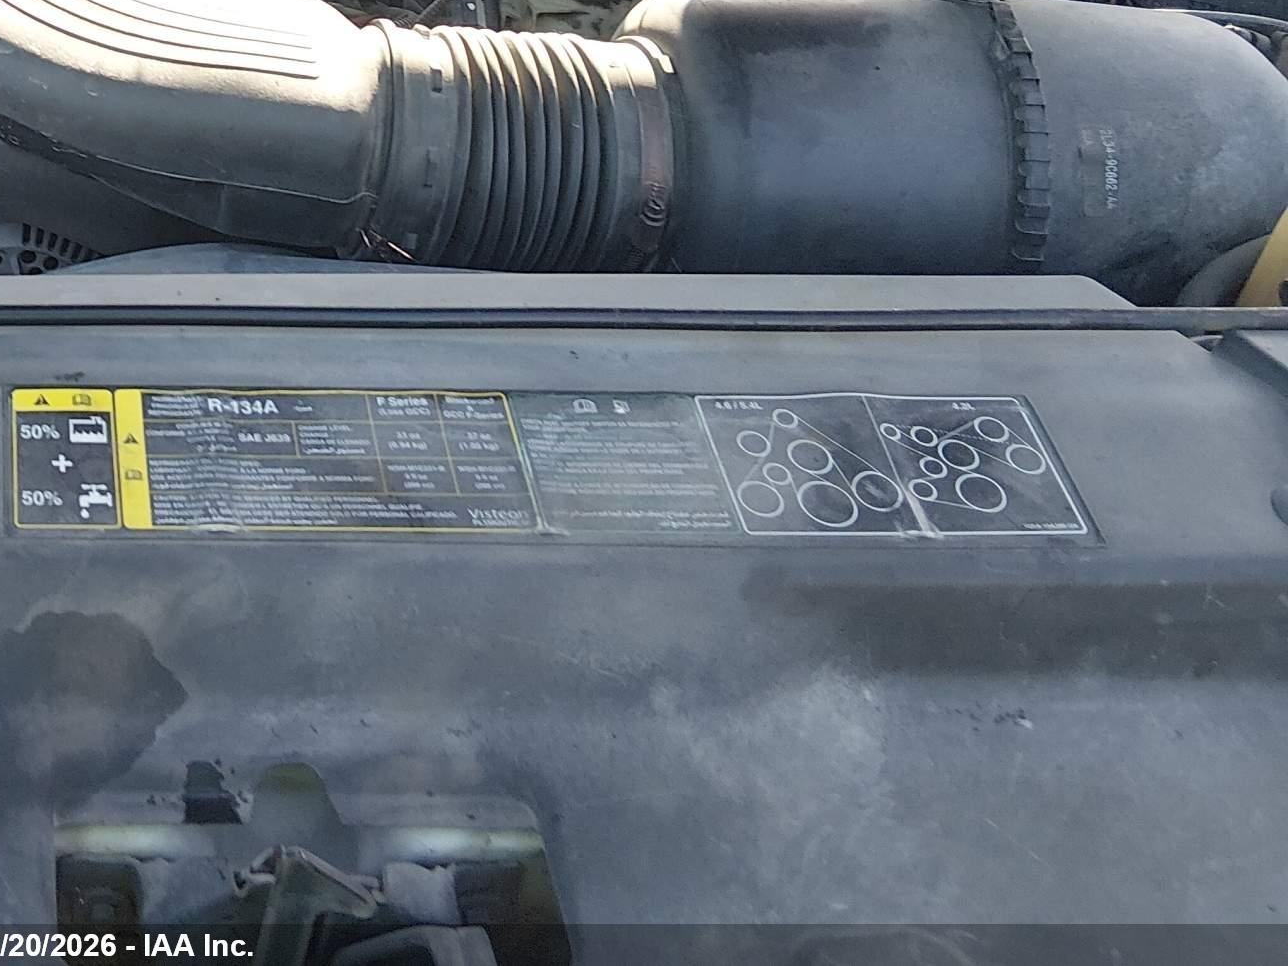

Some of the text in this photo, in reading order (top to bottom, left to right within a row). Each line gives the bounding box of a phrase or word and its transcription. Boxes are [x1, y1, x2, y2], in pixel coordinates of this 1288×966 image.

[207, 398, 279, 415] R-134A
[387, 396, 429, 407] Series
[20, 424, 61, 440] 50%
[21, 490, 63, 506] 50%
[467, 505, 529, 521] Visteon
